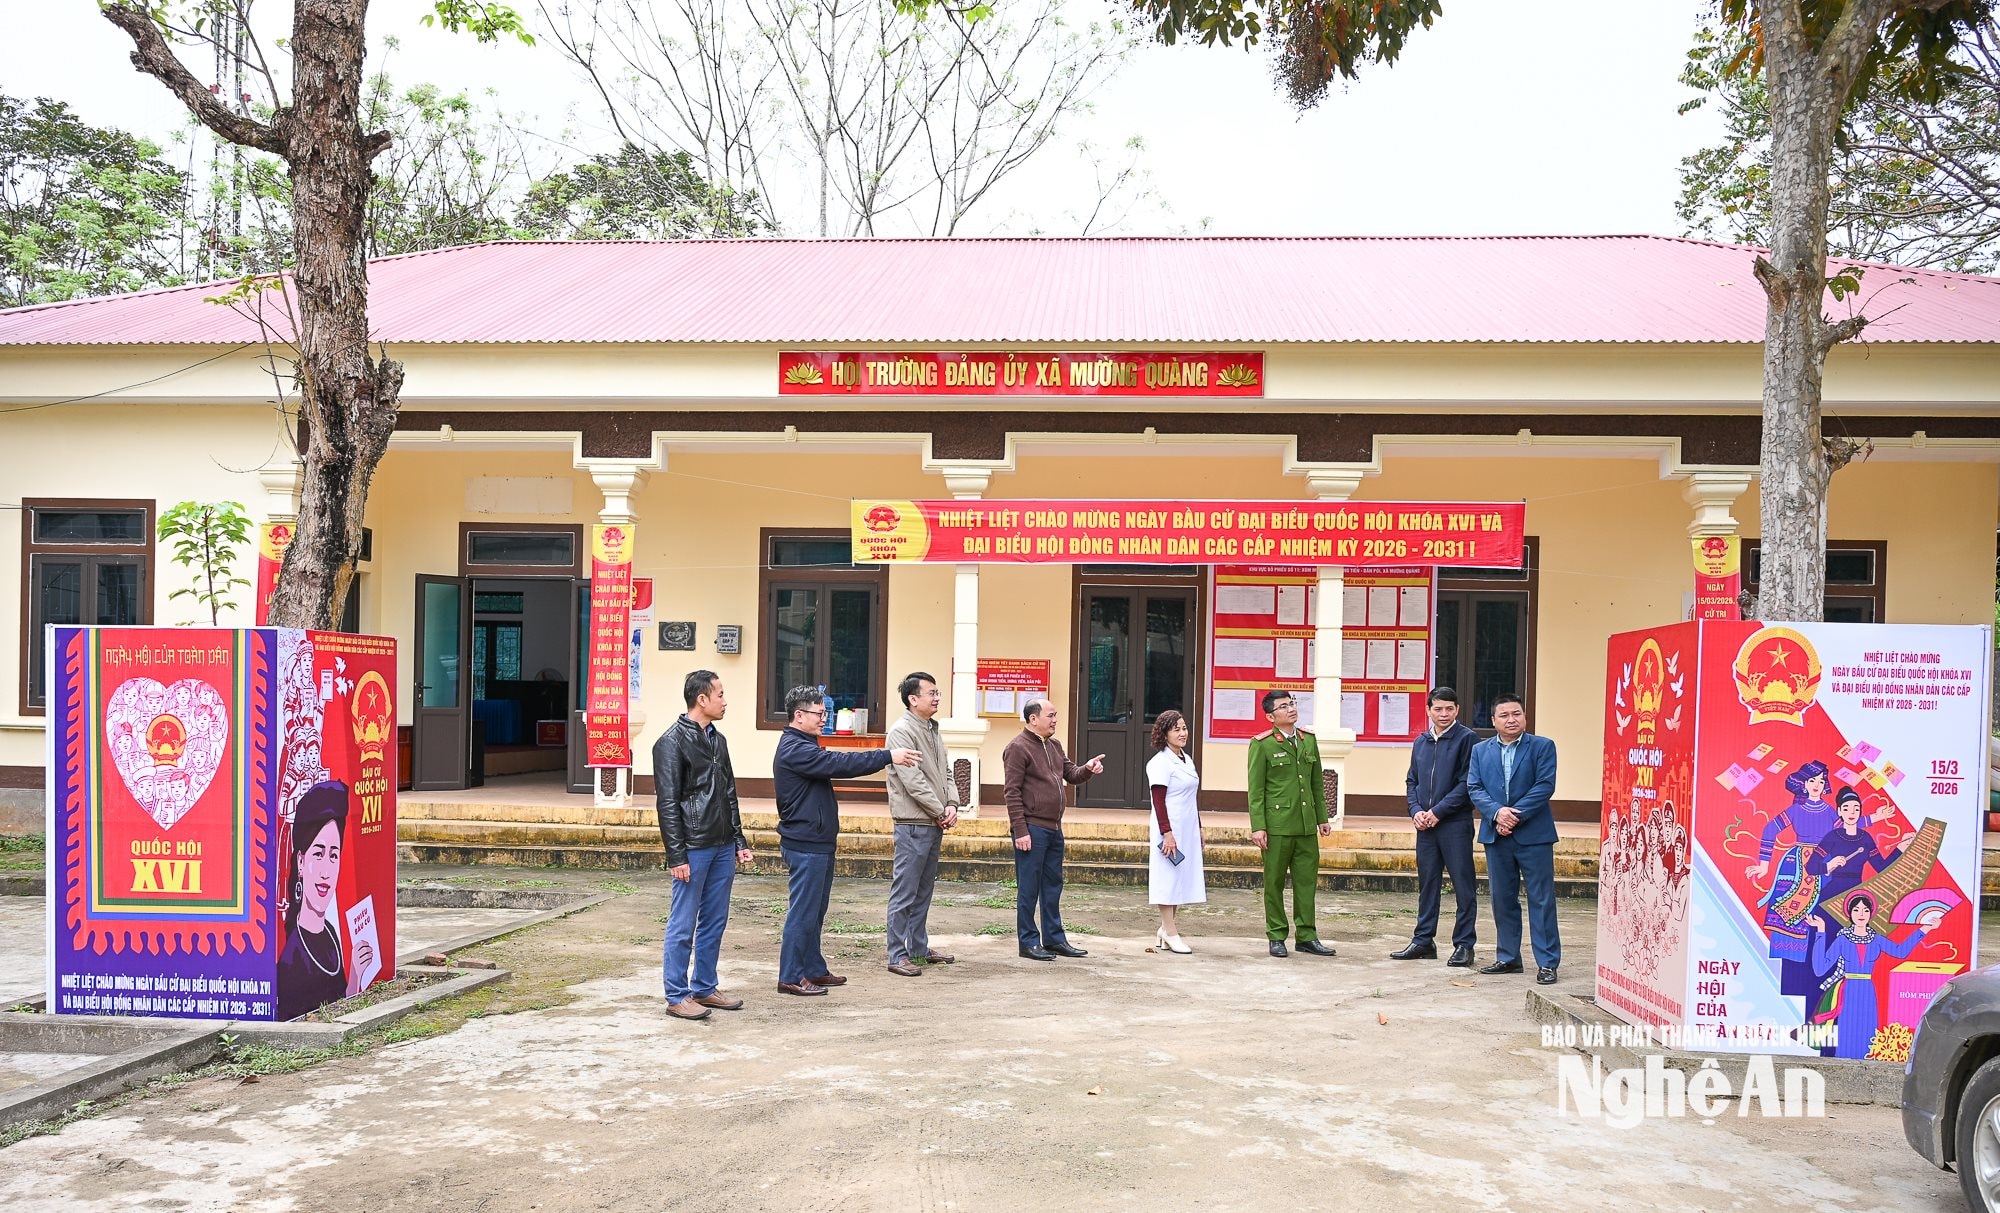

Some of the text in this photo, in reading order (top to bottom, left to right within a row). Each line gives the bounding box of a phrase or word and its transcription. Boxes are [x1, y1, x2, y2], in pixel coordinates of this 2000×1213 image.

[832, 354, 1208, 390] HỘI TRƯỜNG ĐẢNG ỦY XÃ MƯỜNG QUÀNG
[938, 506, 1503, 534] NHIỆT LIỆT CHÀO MỪNG NGÀY BẦU CỬ ĐẠI BIỂU QUỐC HỘI KHÓA XVI VÀ
[963, 537, 990, 556] ĐẠI
[996, 532, 1032, 554] BIỂU
[1036, 535, 1064, 557] HỘI
[1069, 532, 1114, 554] ĐỒNG
[1118, 535, 1162, 555] NHÂN
[1167, 536, 1200, 556] DÂN
[1204, 536, 1238, 556] CÁC
[1242, 533, 1276, 556] CẤP
[1280, 536, 1332, 560] NHIỆM
[1338, 536, 1359, 557] KỲ
[1363, 540, 1407, 558] 2026
[1422, 540, 1464, 558] 2031
[1706, 582, 1725, 592] NGÀY
[592, 598, 608, 608] NGÀY
[1704, 609, 1726, 618] CỬ TRI
[105, 644, 229, 668] NGÀY HỘI CỦA TOÀN DÂN
[1864, 650, 1884, 664] NHIỆT
[1886, 650, 1898, 664] LIỆT
[1900, 651, 1918, 664] CHÀO
[1832, 665, 1850, 676] NGÀY
[1878, 668, 1888, 680] ĐẠI
[1890, 664, 1906, 678] BIỂU
[1908, 666, 1926, 680] QUỐC
[1928, 667, 1938, 682] HỘI
[1940, 668, 1958, 680] KHÓA
[1960, 670, 1972, 680] XVI
[594, 686, 610, 695] NHÂN
[1832, 681, 1840, 692] VÀ
[1842, 682, 1854, 695] ĐẠI
[1855, 680, 1870, 694] BIỂU
[1872, 682, 1884, 696] HỘI
[1906, 682, 1924, 695] NHÂN
[1926, 683, 1940, 696] DÂN
[1942, 684, 1955, 696] CÁC
[1957, 682, 1970, 696] CẤP
[594, 700, 607, 710] CÁC
[1862, 696, 1884, 710] NHIỆM
[1896, 700, 1912, 710] 2026
[592, 715, 612, 726] NHIỆM
[588, 730, 604, 739] 2026
[1628, 744, 1662, 770] QUỐC HỘI
[1931, 760, 1958, 774] 15/3
[354, 776, 388, 795] QUỐC HỘI
[1636, 766, 1654, 788] XVI
[1931, 782, 1958, 795] 2026
[361, 794, 382, 824] XVI
[131, 836, 202, 858] QUỐC HỘI
[130, 858, 202, 894] XVI
[1698, 958, 1740, 976] NGÀY
[62, 972, 80, 991] NHIỆT
[82, 972, 94, 991] LIỆT
[96, 973, 114, 990] CHÀO
[114, 972, 134, 990] MỪNG
[136, 974, 153, 990] NGÀY
[169, 972, 180, 992] CỬ
[180, 978, 190, 994] ĐẠI
[192, 974, 208, 992] BIỂU
[208, 975, 226, 994] QUỐC
[228, 978, 240, 996] HỘI
[240, 978, 258, 994] KHÓA
[260, 981, 270, 995] XVI
[1696, 979, 1726, 998] HỘI
[62, 992, 72, 1008] VÀ
[72, 996, 84, 1012] ĐẠI
[85, 990, 100, 1010] BIỂU
[102, 994, 112, 1012] HỘI
[132, 994, 152, 1011] NHÂN
[152, 996, 166, 1012] DÂN
[168, 996, 181, 1012] CÁC
[182, 994, 196, 1012] CẤP
[197, 997, 218, 1016] NHIỆM
[220, 998, 229, 1014] KỲ
[230, 1001, 246, 1014] 2026
[1900, 990, 1916, 998] HÒM
[1696, 999, 1727, 1016] CỦA
